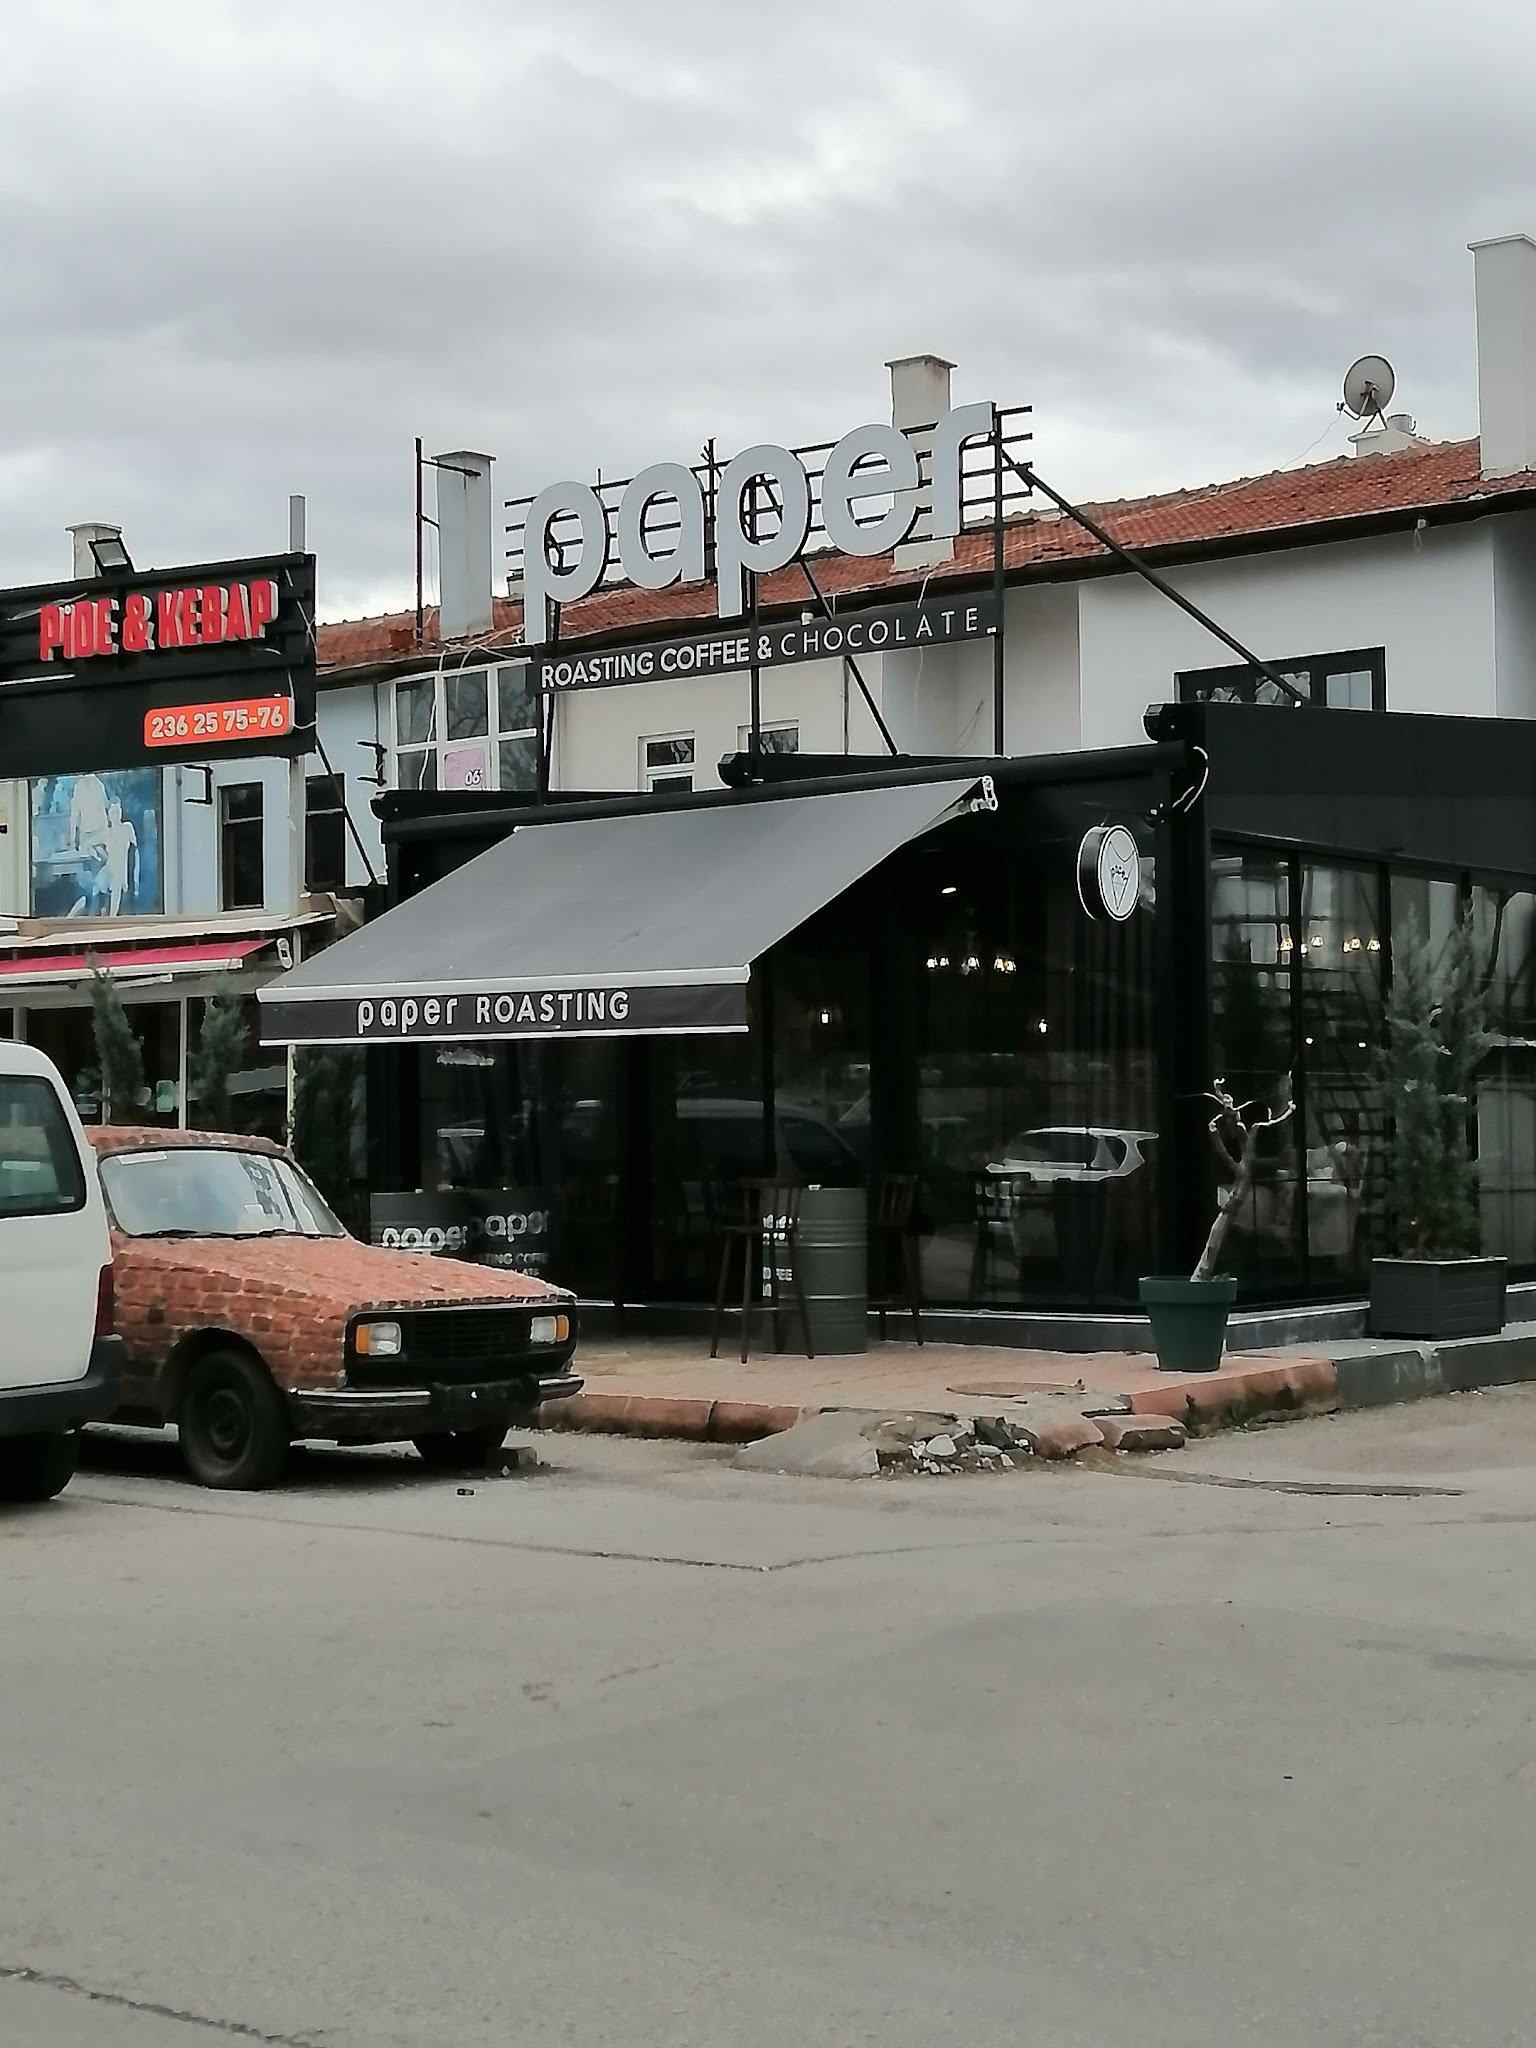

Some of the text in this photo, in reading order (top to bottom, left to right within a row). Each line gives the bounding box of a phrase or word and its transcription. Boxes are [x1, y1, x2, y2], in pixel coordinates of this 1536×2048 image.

[523, 401, 996, 646] paper
[122, 594, 156, 651] &
[158, 579, 279, 648] KEBAP
[541, 607, 979, 689] ROASTING COFFEE & CHOCOLATE
[151, 705, 284, 738] 236 25 75-76
[357, 991, 630, 1034] paper ROASTING
